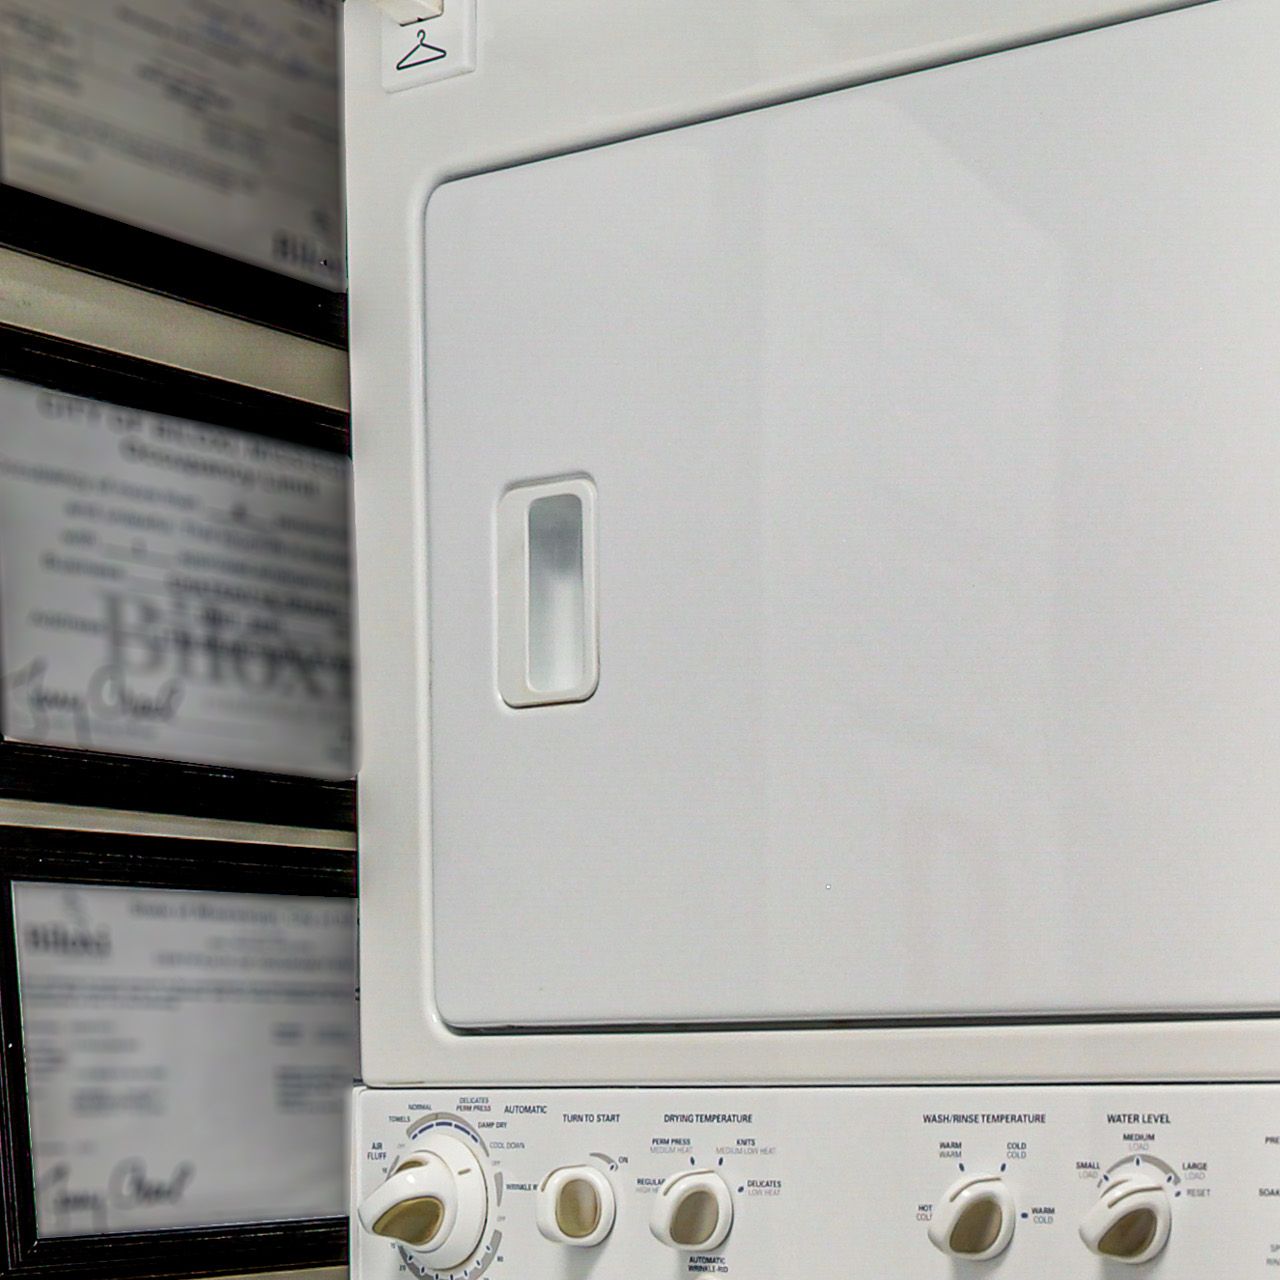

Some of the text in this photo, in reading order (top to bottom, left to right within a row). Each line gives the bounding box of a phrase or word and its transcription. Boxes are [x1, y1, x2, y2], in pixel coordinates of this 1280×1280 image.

[504, 1105, 547, 1114] AUTOMATIC
[563, 1114, 620, 1123] TURN TO START
[664, 1114, 753, 1123] DRYING TEMPERATURE
[923, 1114, 1046, 1124] WASH/RINSE TEMPERATURE
[1107, 1114, 1171, 1124] WATER LEVEL
[1123, 1133, 1155, 1141] MEDIUM
[1007, 1142, 1026, 1150] COLD
[367, 1151, 386, 1160] FLUFF
[1076, 1162, 1100, 1170] SMALL
[747, 1180, 782, 1188] DELICATES
[1033, 1215, 1053, 1224] COLD
